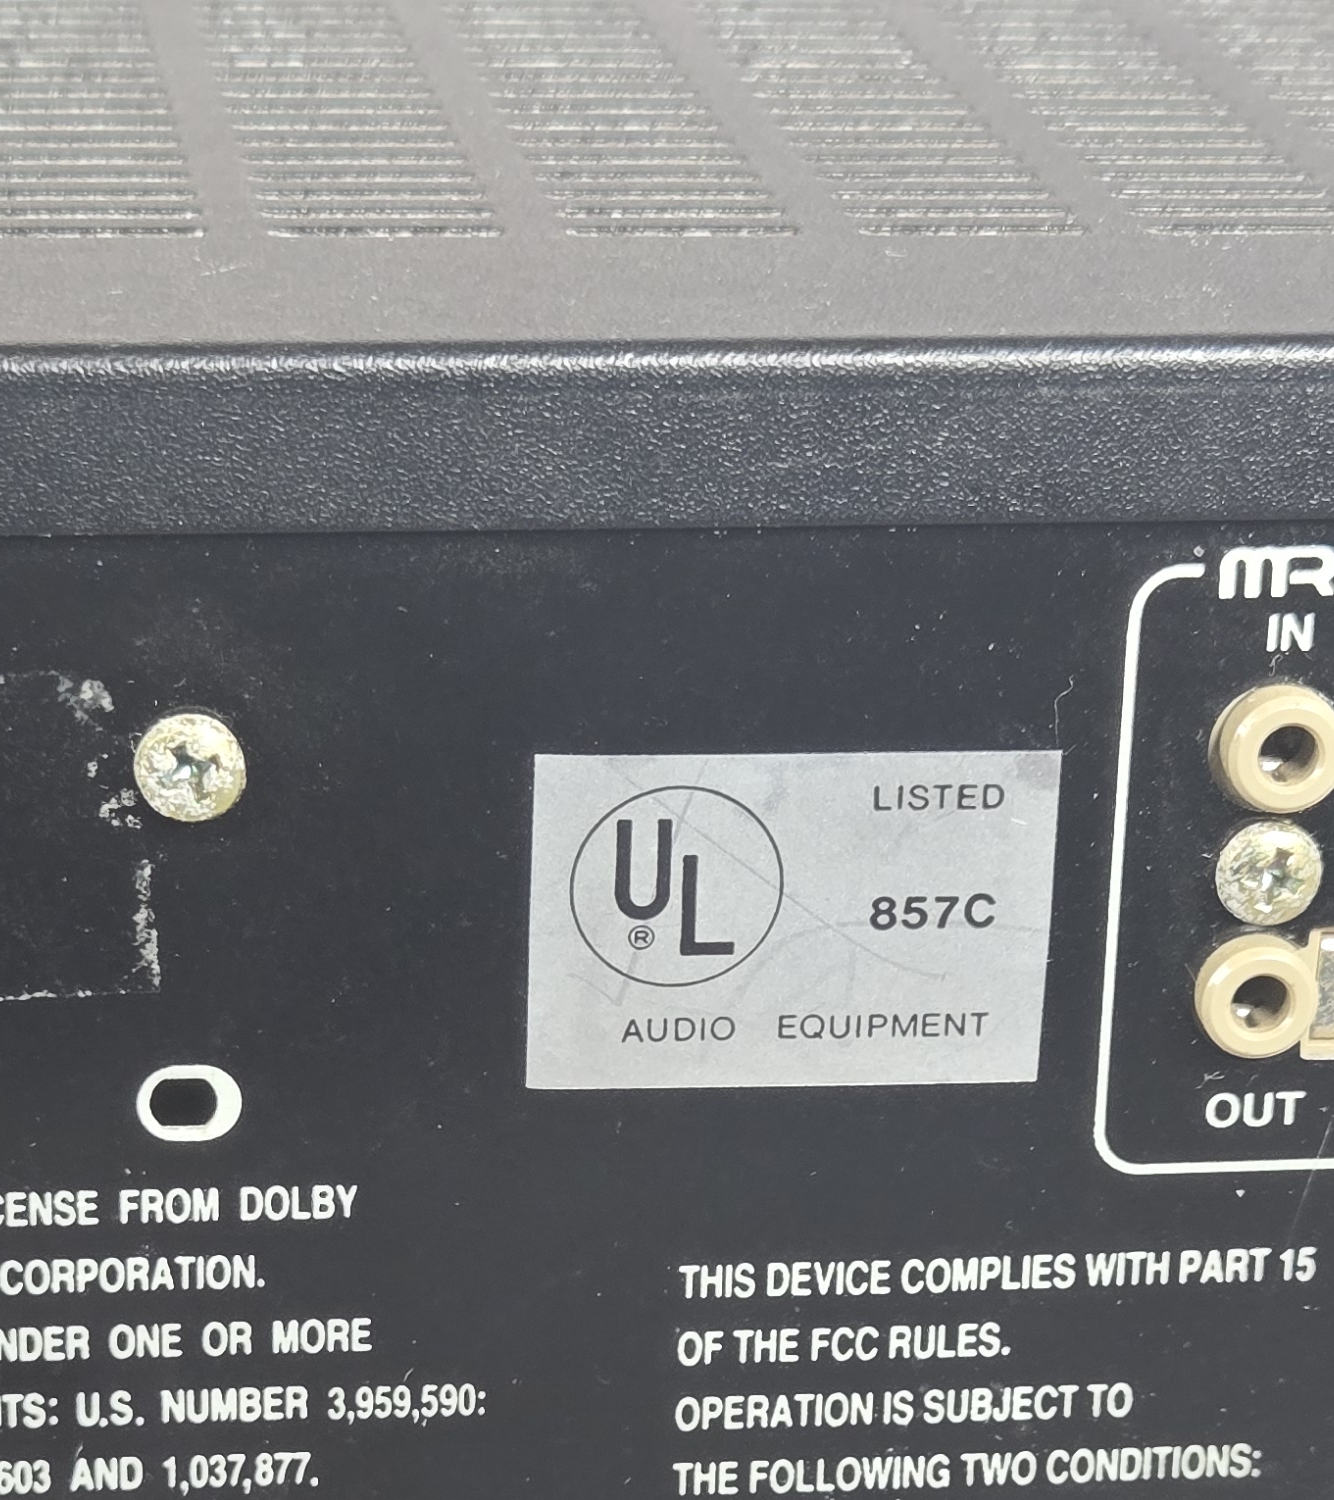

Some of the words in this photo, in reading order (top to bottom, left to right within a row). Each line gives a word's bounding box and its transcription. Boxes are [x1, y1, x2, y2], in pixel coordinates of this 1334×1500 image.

[1266, 613, 1315, 652] IN
[874, 784, 1004, 811] LISTED
[870, 893, 996, 930] 857C
[622, 1017, 735, 1043] AUDIO
[778, 1012, 989, 1039] EQUIPMENT
[1206, 1091, 1306, 1128] OUT
[119, 1188, 219, 1224] FROM
[240, 1185, 357, 1221] DOLBY
[679, 1263, 755, 1298] THIS
[767, 1260, 891, 1296] DEVICE
[901, 1253, 1076, 1294] COMPLIES
[1085, 1251, 1170, 1286] WITH
[1179, 1247, 1272, 1284] PART
[1280, 1247, 1317, 1281] 15
[109, 1323, 183, 1359] ONE
[202, 1322, 252, 1356] OR
[272, 1318, 372, 1353] MORE
[677, 1331, 724, 1366] OF
[733, 1328, 799, 1363] THE
[811, 1326, 879, 1361] FCC
[889, 1322, 1010, 1360] RULES.
[76, 1390, 144, 1427] U.S.
[160, 1386, 308, 1423] NUMBER
[328, 1383, 486, 1426] 3,959,590:
[675, 1392, 873, 1431] OPERATION
[883, 1390, 914, 1426] IS
[923, 1385, 1079, 1424] SUBJECT
[1087, 1382, 1133, 1418] TO
[70, 1457, 143, 1491] AND
[163, 1452, 318, 1496] 1,037,877.
[673, 1461, 738, 1496] THE
[750, 1454, 950, 1494] FOLLOWING
[960, 1451, 1037, 1486] TWO
[1046, 1443, 1261, 1484] CONDITIONS:
